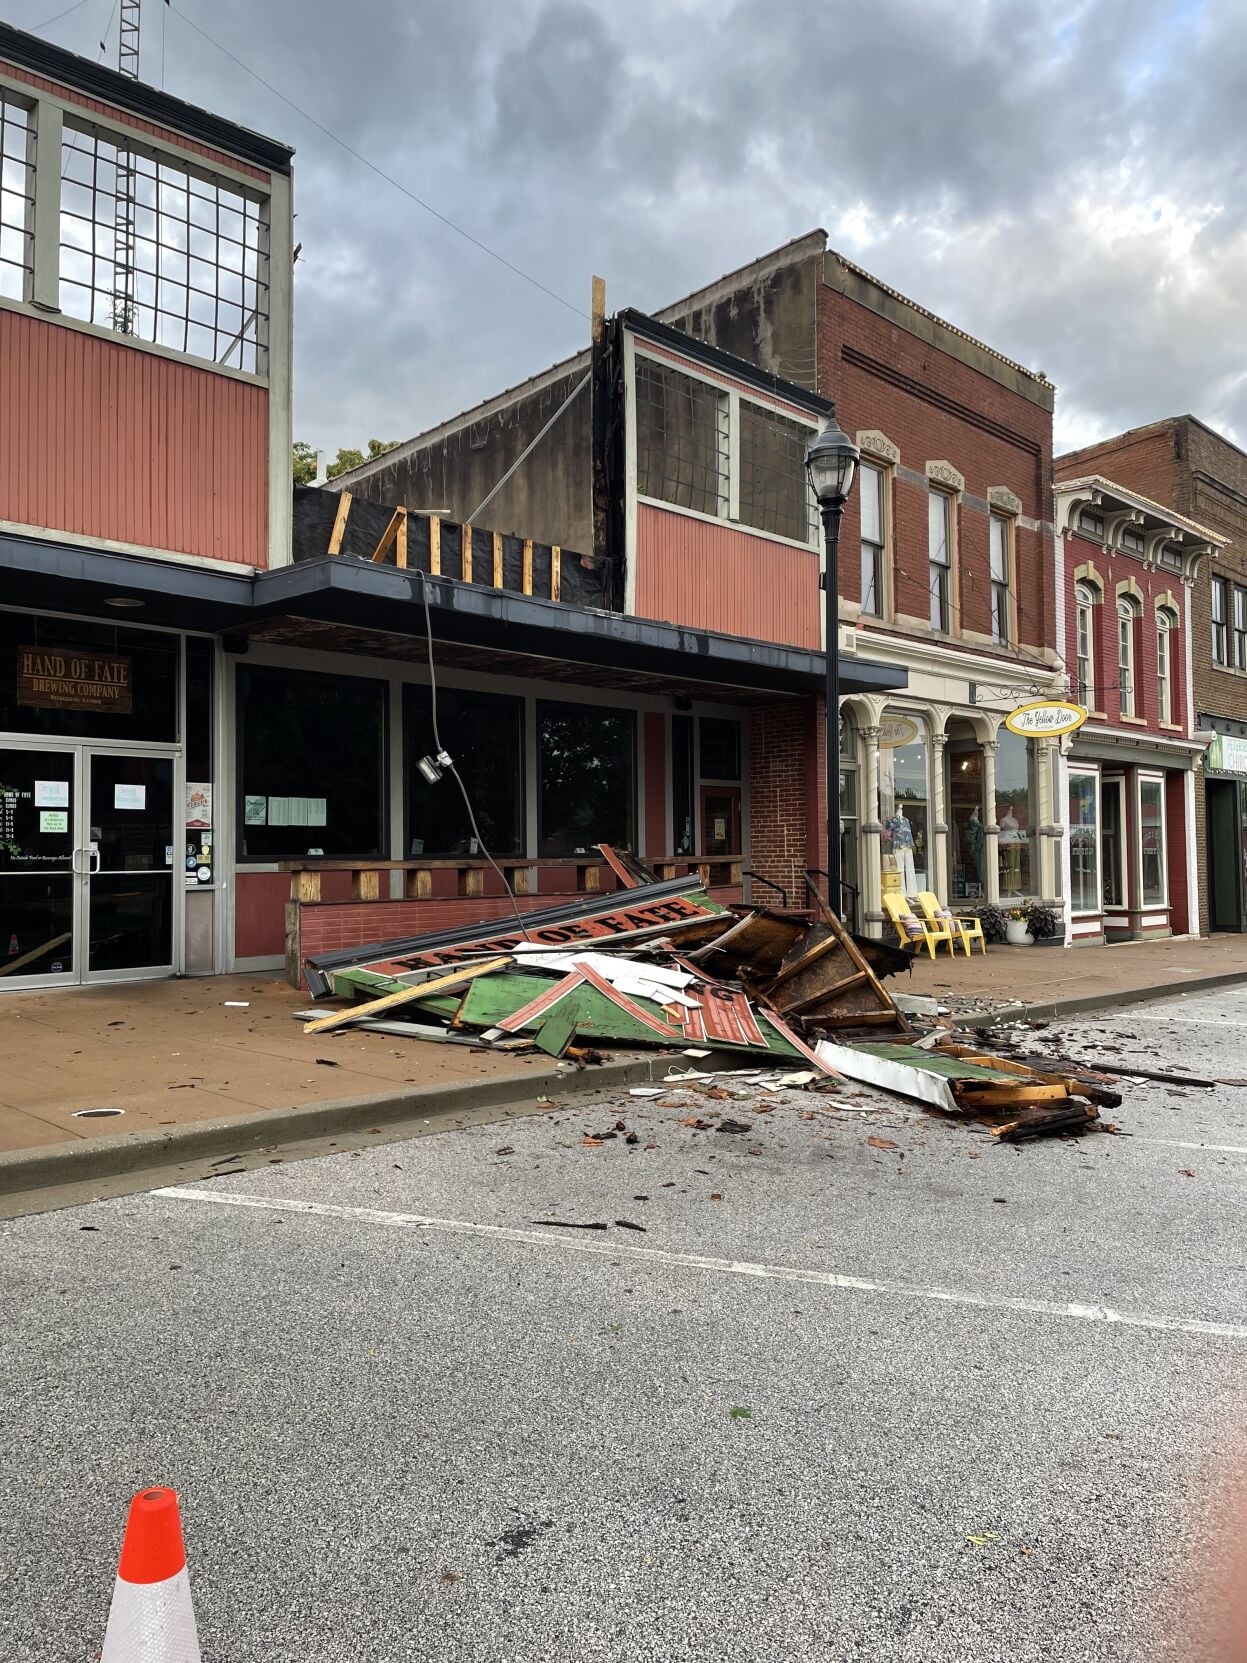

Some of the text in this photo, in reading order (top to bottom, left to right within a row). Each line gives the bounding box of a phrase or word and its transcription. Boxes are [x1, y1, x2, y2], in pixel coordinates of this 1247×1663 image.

[22, 653, 128, 683] HAND OF FATE
[33, 679, 120, 699] BREWING COMPANY
[1021, 708, 1072, 728] The Yellow Door
[537, 924, 593, 943] OF
[594, 901, 700, 934] FATE
